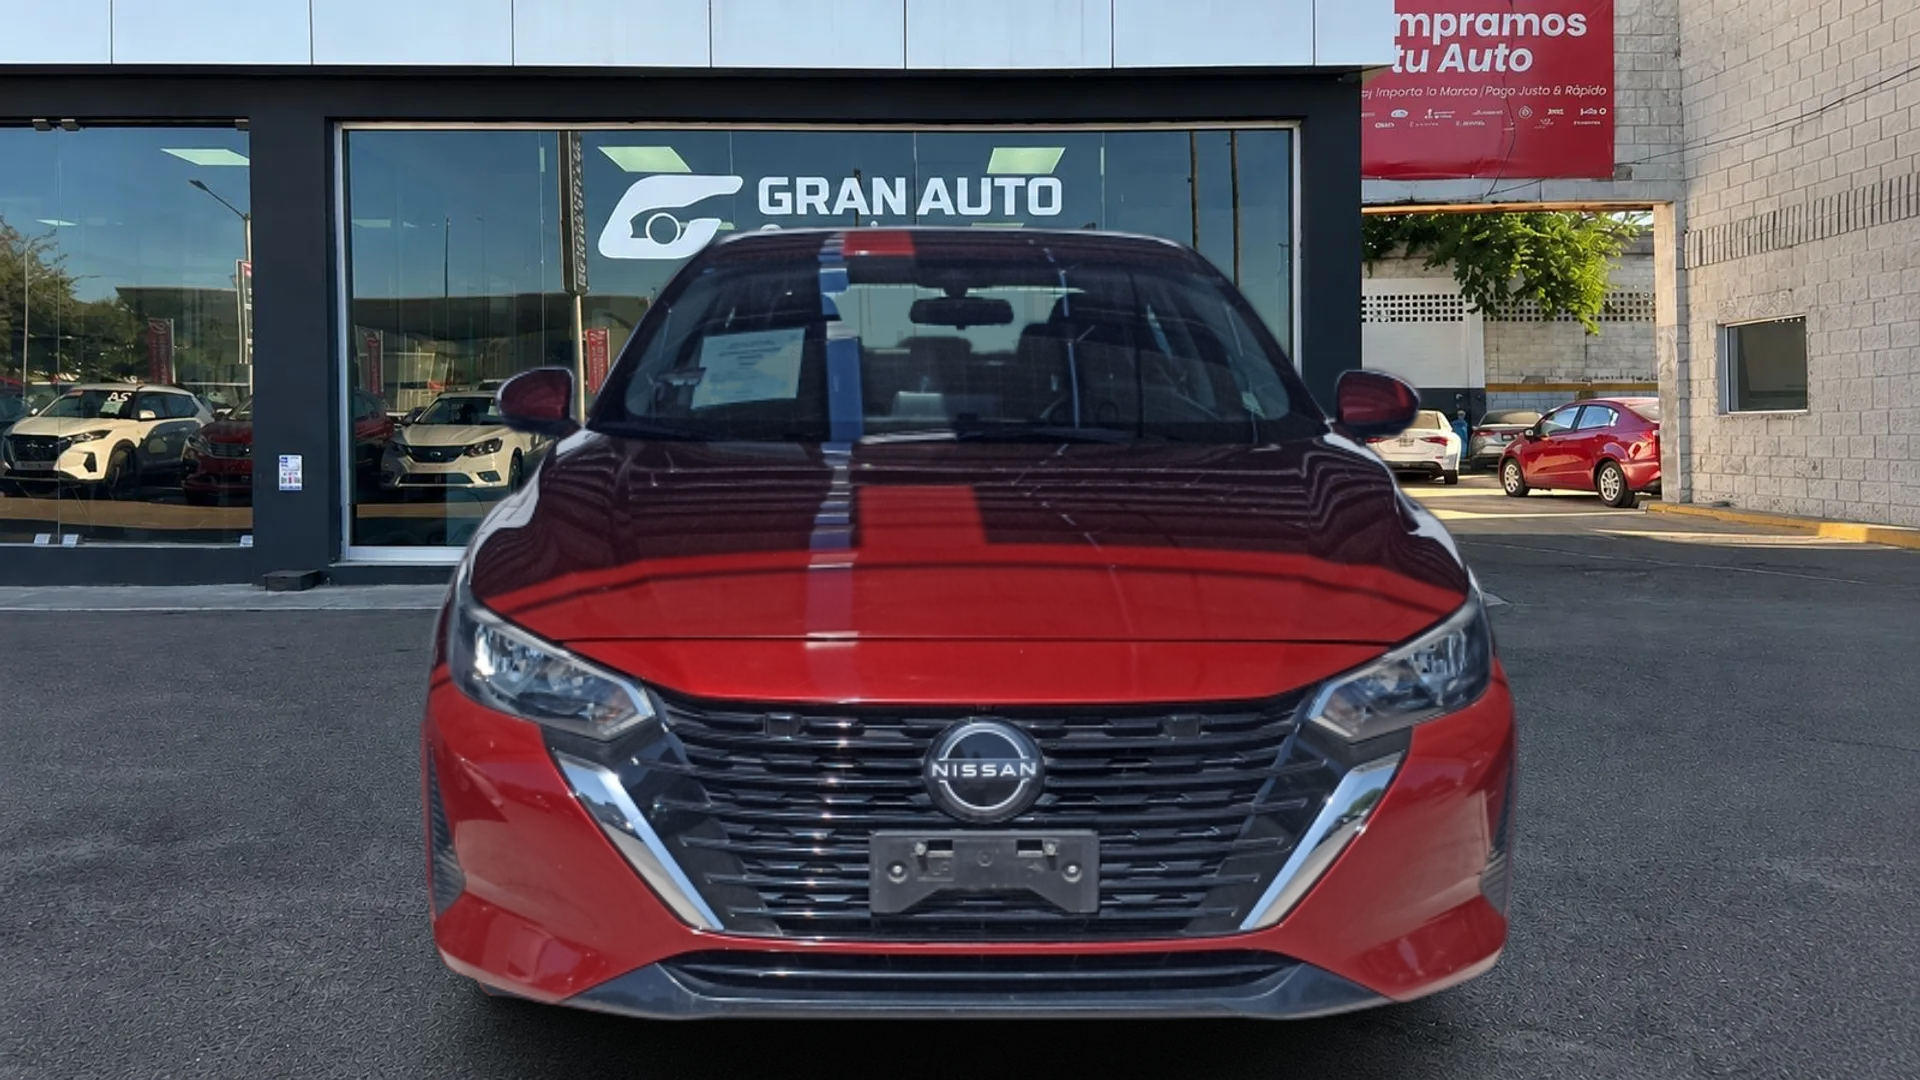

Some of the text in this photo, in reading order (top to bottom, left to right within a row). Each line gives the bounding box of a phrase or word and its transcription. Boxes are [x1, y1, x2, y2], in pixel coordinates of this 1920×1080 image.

[1392, 43, 1533, 73] tu Auto
[1375, 87, 1423, 99] Importa
[1440, 86, 1478, 97] Marca
[1518, 85, 1551, 96] Justo
[758, 176, 1063, 216] GRAN AUTO
[931, 761, 1037, 778] NISSAN
